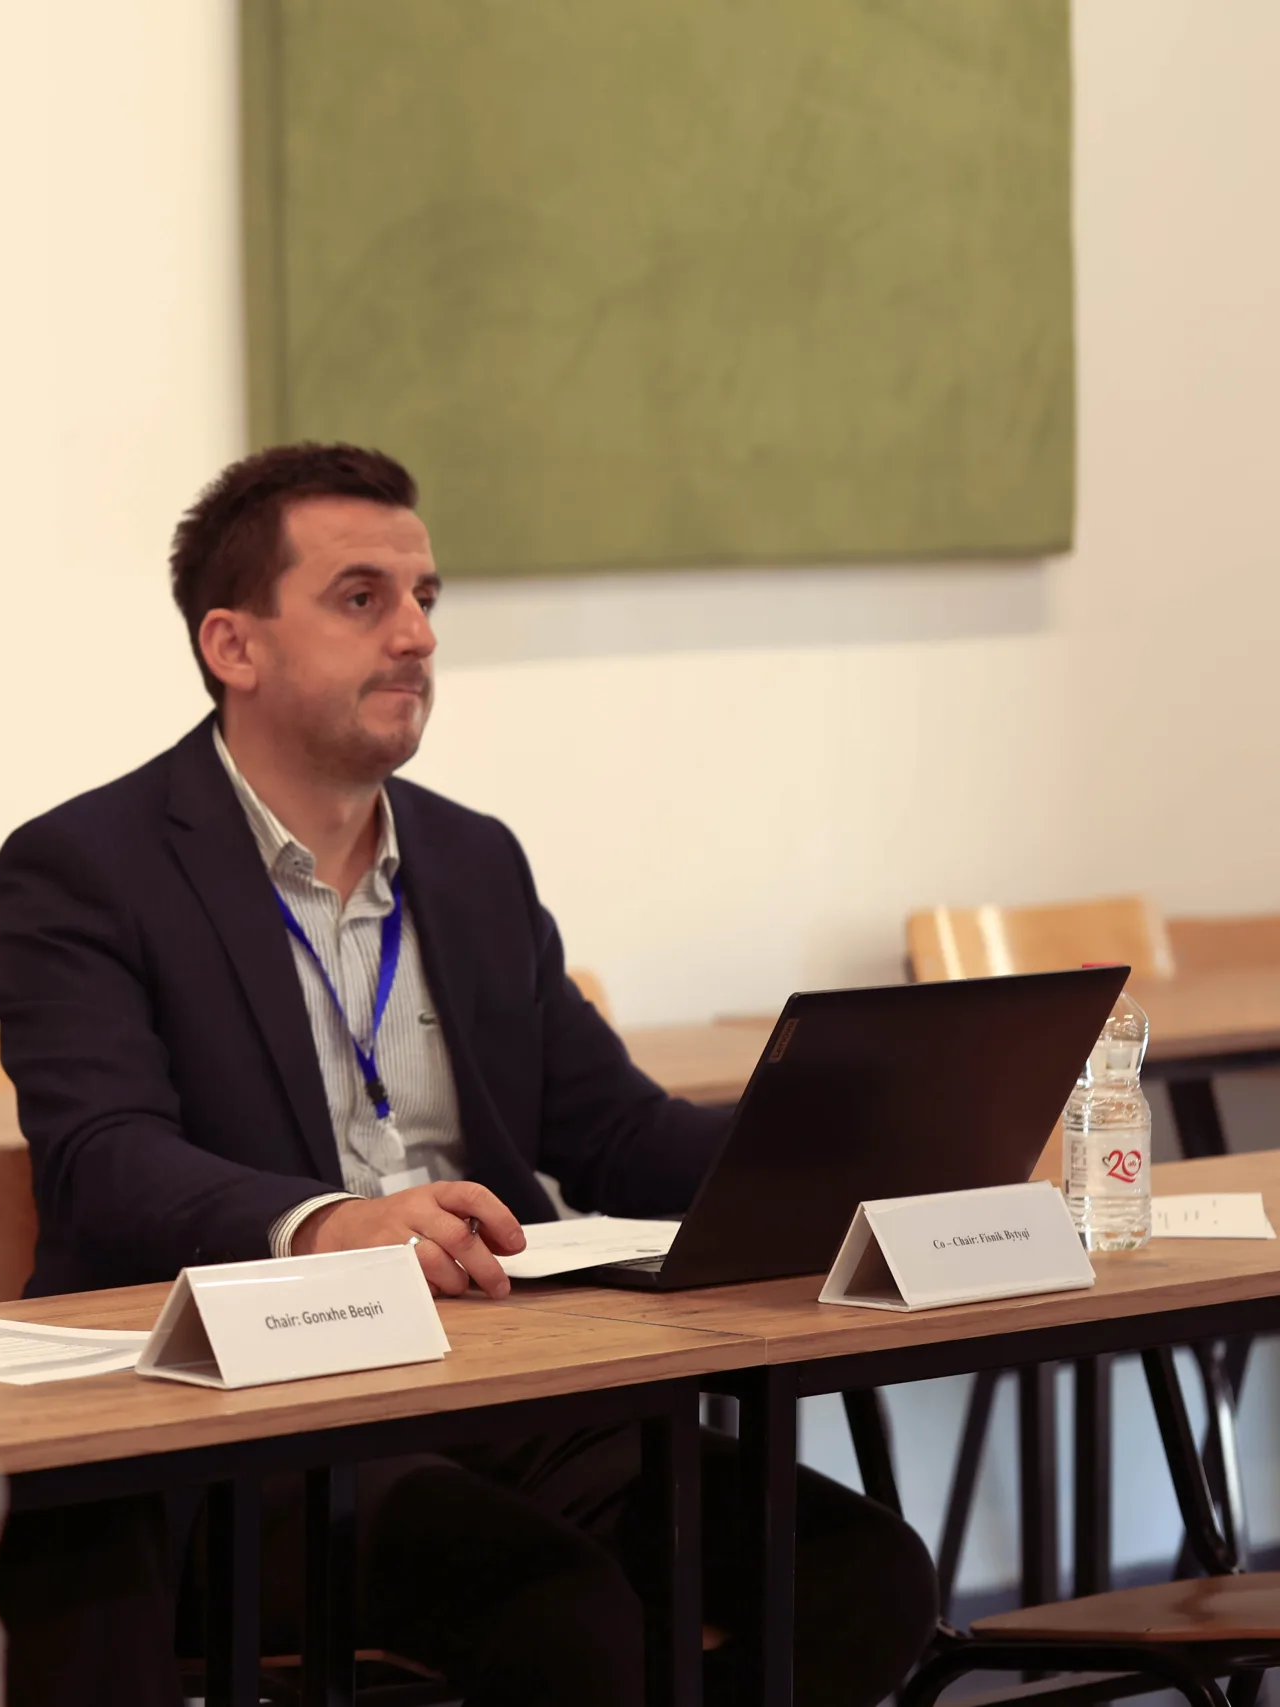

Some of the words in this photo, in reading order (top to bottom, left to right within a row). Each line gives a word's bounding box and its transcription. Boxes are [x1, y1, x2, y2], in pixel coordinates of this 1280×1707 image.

[772, 1021, 796, 1059] Lenovo
[1106, 1149, 1142, 1183] 20
[933, 1239, 946, 1249] Co
[952, 1235, 979, 1247] Chair:
[979, 1231, 1004, 1244] Fisnik
[1003, 1228, 1030, 1242] Bytyqi
[265, 1313, 301, 1330] Chair:
[302, 1307, 347, 1325] Gonxhe
[348, 1301, 384, 1319] Beqiri
